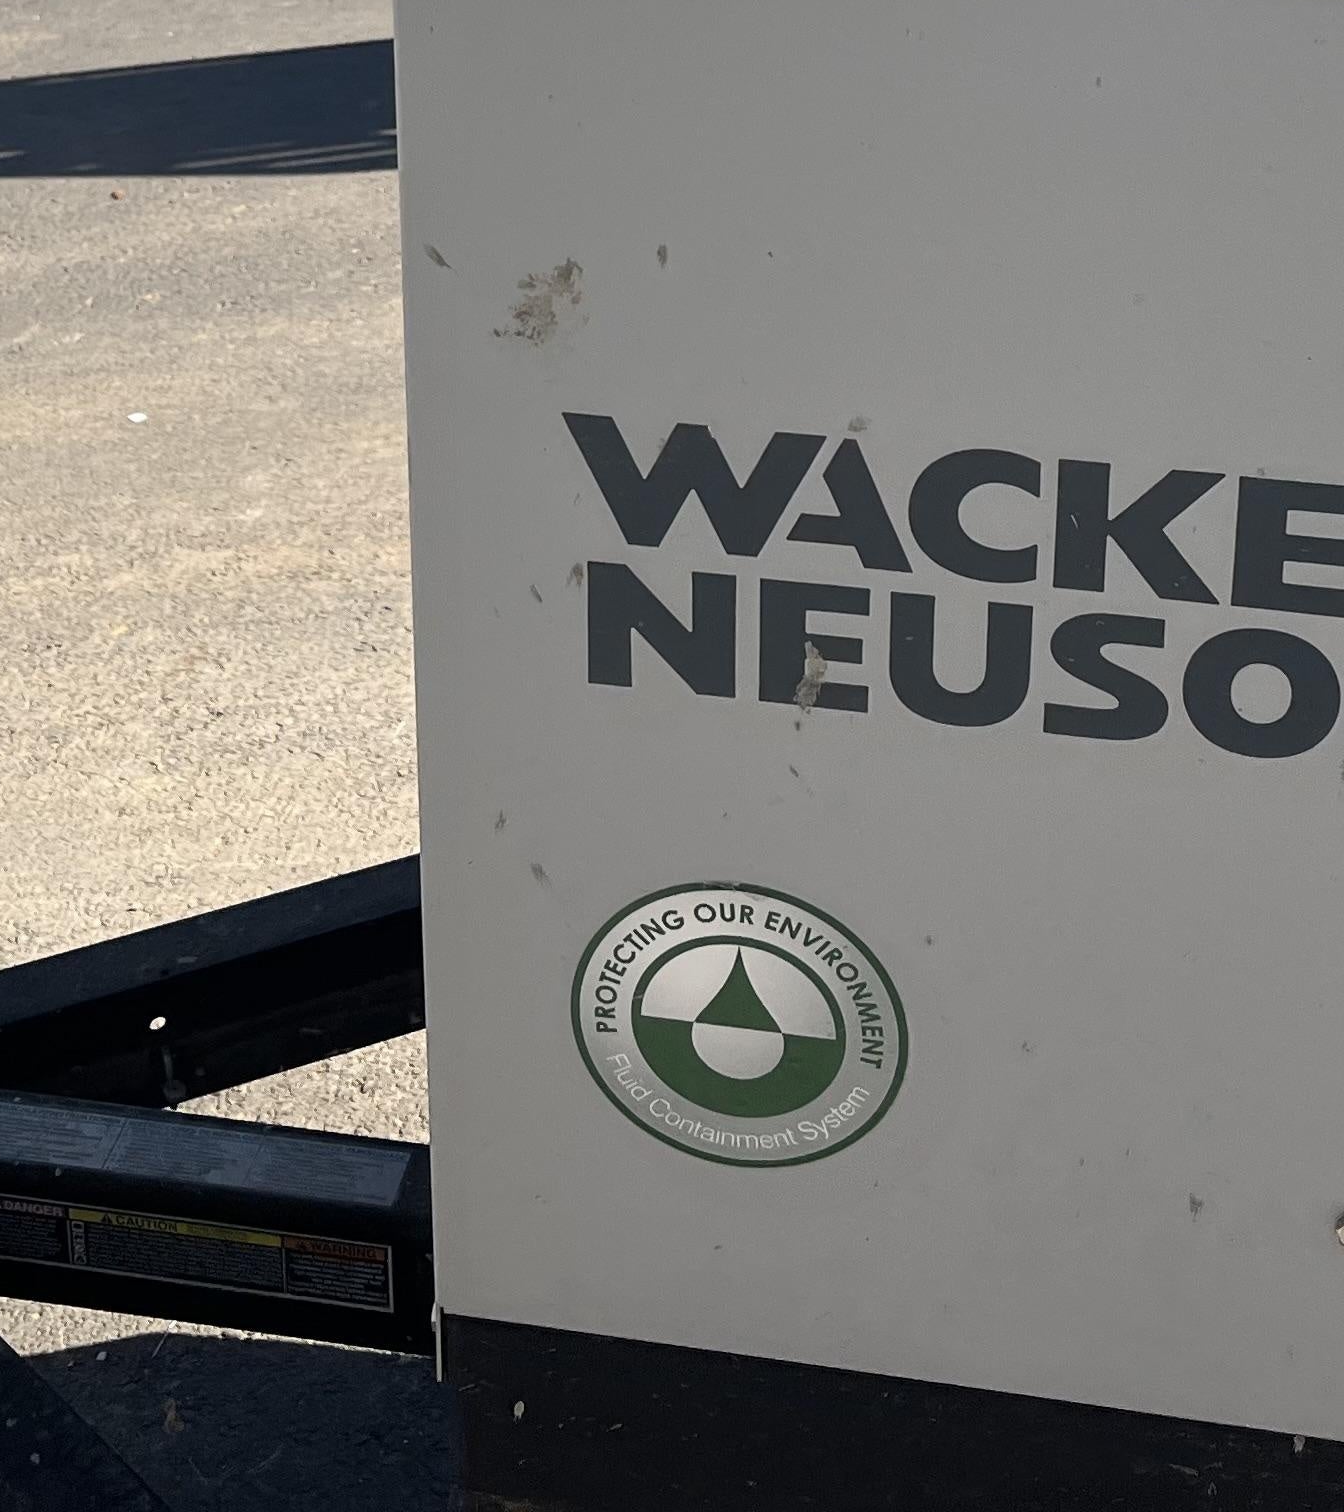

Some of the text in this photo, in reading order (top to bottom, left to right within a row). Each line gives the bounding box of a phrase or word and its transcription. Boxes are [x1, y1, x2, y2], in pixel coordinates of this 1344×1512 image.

[594, 902, 885, 1069] PROTECTING OUR ENVIRONMENT
[606, 1052, 870, 1149] Fluid Containment System
[3, 1200, 64, 1217] DANGER
[115, 1215, 178, 1233] CAUTION
